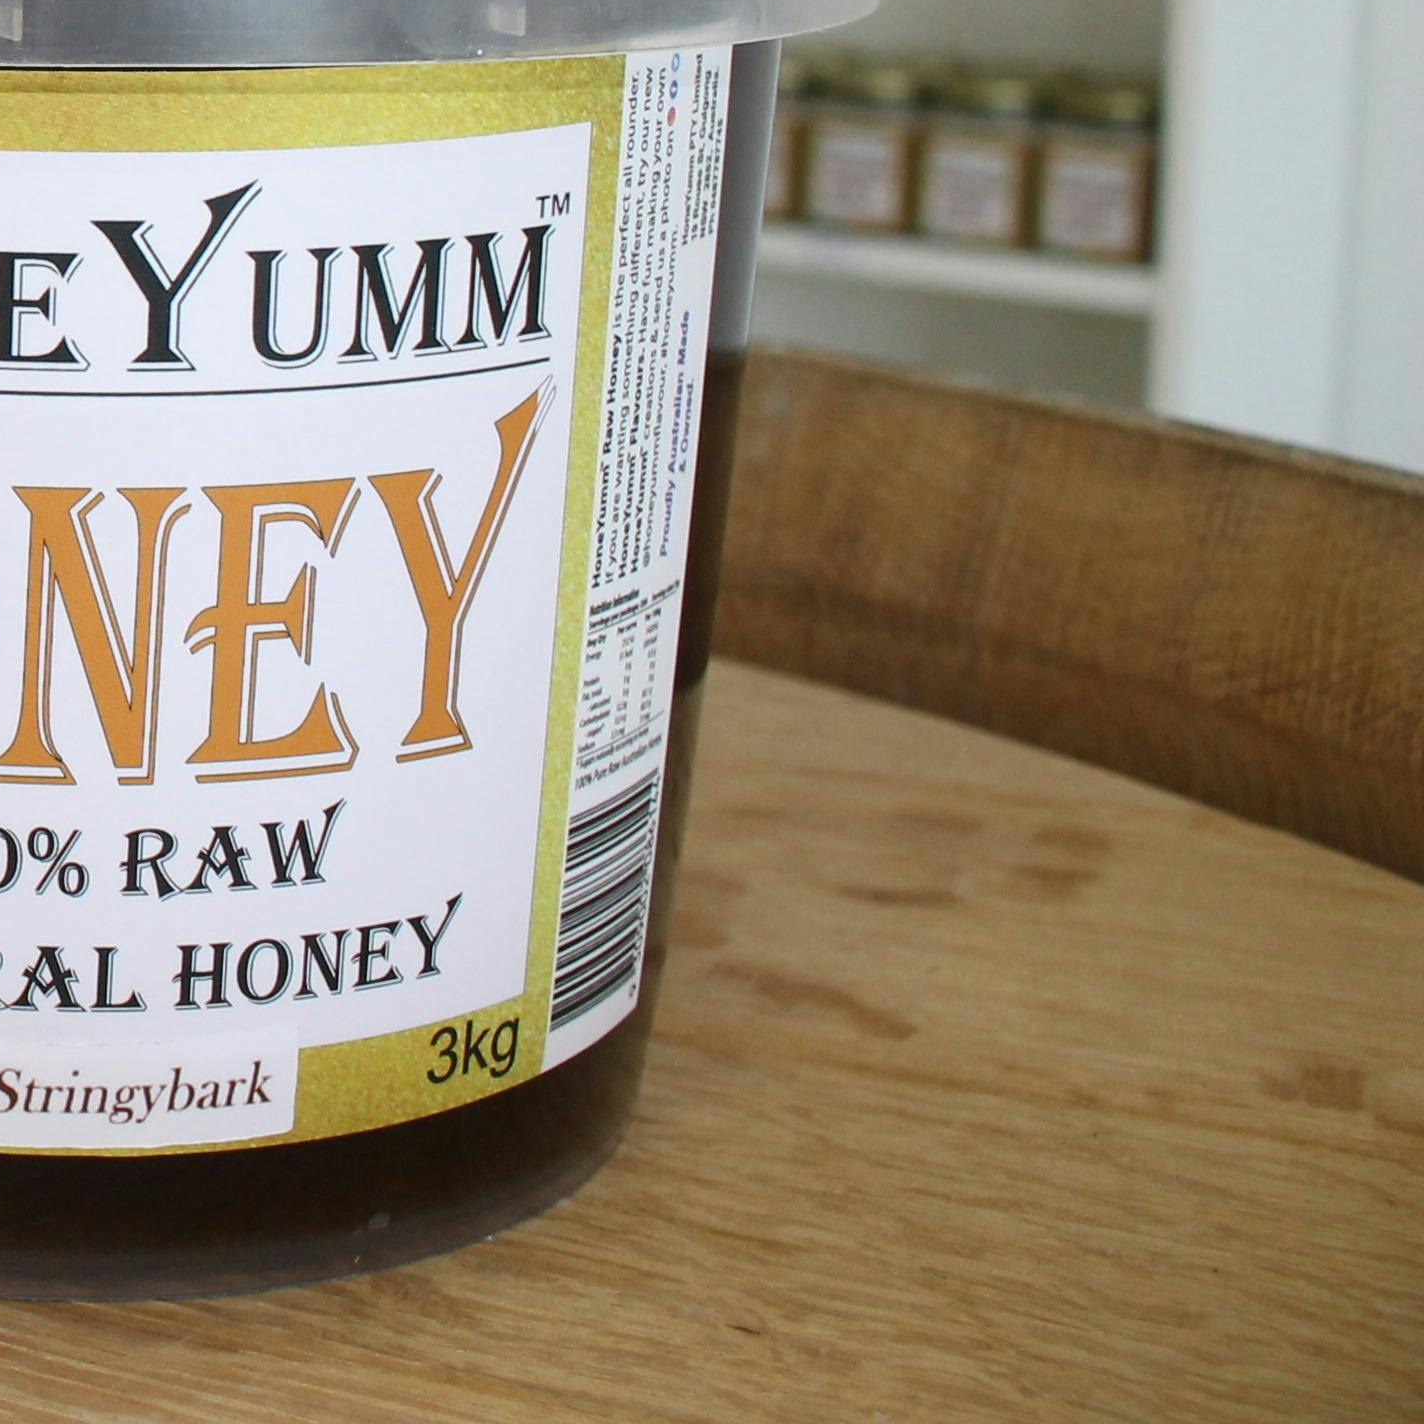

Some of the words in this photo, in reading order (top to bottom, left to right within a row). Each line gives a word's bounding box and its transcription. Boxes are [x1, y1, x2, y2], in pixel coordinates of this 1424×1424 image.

[643, 66, 653, 111] new
[657, 67, 666, 112] own
[691, 52, 703, 114] Limited
[640, 117, 649, 152] our
[653, 118, 662, 165] your
[666, 130, 674, 157] on
[688, 118, 697, 150] PTY
[623, 165, 632, 187] all
[636, 158, 649, 187] try
[660, 162, 671, 224] photo
[618, 194, 630, 267] perfect
[647, 170, 661, 247] making
[657, 246, 665, 270] us
[659, 230, 666, 241] a
[614, 274, 625, 307] the
[641, 253, 652, 287] fun
[612, 313, 622, 328] is
[637, 292, 649, 343] Have
[652, 275, 663, 323] send
[622, 289, 639, 399] something
[649, 328, 658, 343] &
[676, 310, 689, 365] Made
[606, 333, 622, 404] Honey
[643, 348, 657, 440] creations
[602, 409, 614, 455] Raw
[667, 371, 683, 474] Australian
[614, 404, 630, 488] wanting
[678, 458, 687, 473] &
[611, 492, 621, 523] are
[659, 479, 676, 557] Proudly
[608, 528, 618, 566] you
[604, 570, 614, 584] If
[119, 799, 347, 900] RAW
[170, 891, 463, 1011] HONEY
[424, 1016, 521, 1085] 3kg
